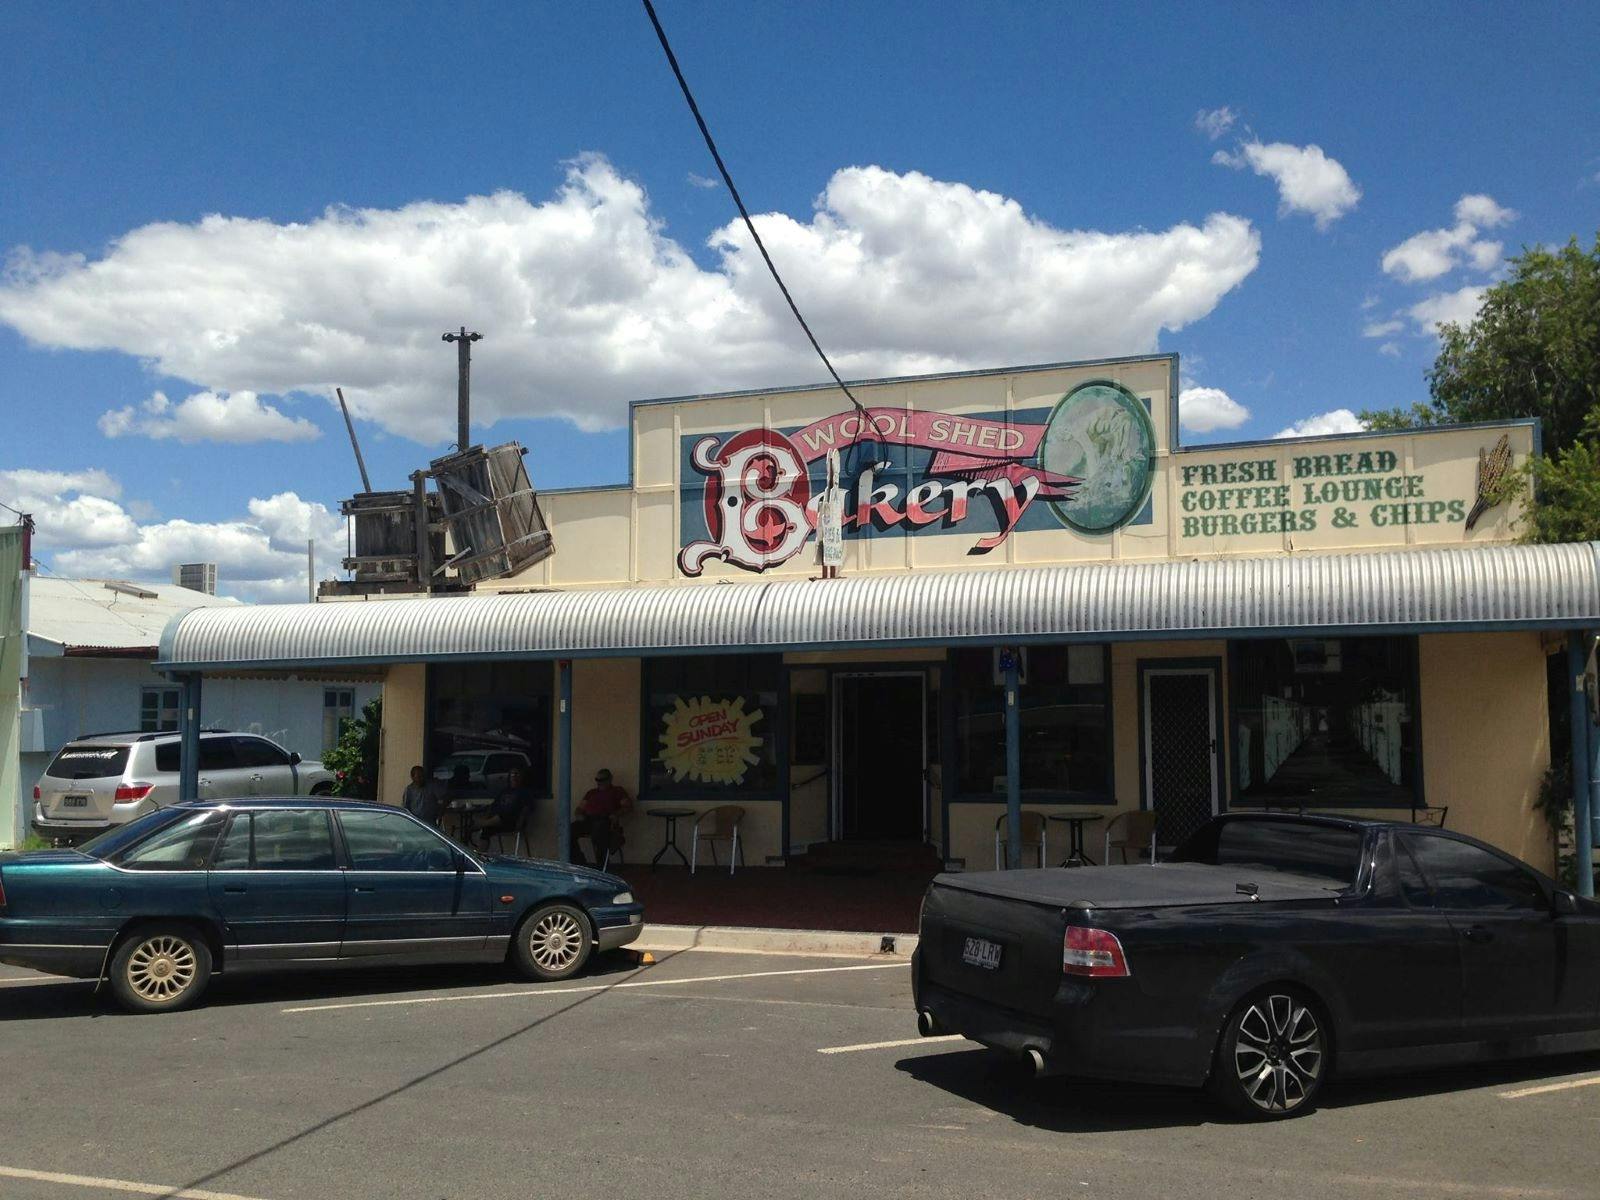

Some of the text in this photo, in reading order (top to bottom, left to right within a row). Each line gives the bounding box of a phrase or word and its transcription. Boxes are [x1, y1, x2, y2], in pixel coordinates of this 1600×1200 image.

[801, 414, 1025, 452] WOOL SHED
[1181, 450, 1398, 487] FRESH BREAD
[1181, 475, 1425, 513] COFFEE LOUNGE
[1181, 499, 1465, 538] BURGERS & CHIPS
[676, 718, 741, 748] SUNDAY
[688, 709, 727, 729] OPEN
